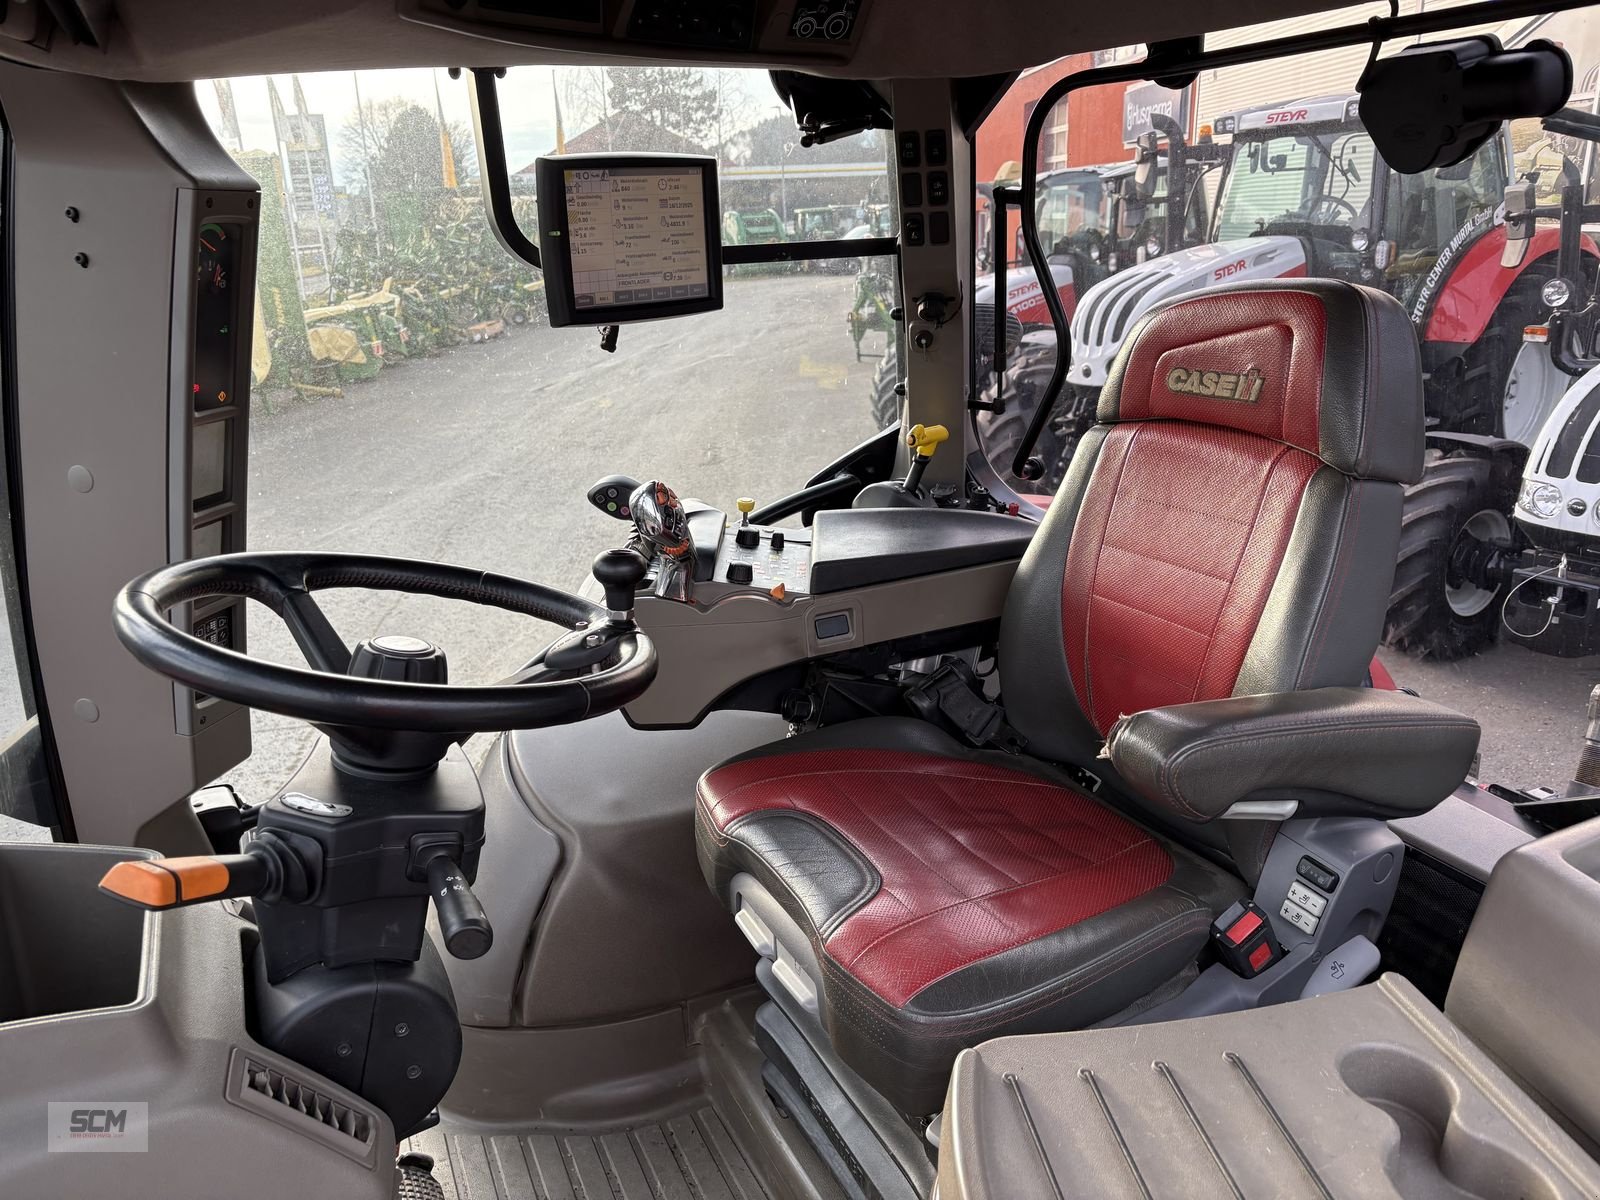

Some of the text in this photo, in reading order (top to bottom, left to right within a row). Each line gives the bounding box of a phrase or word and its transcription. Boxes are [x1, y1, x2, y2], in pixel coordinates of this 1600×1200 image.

[1265, 109, 1308, 124] STEYR
[1214, 259, 1247, 281] STEYR
[1411, 205, 1493, 324] STEYR CENTER MURTAL GmbH
[1008, 281, 1039, 299] STEYR
